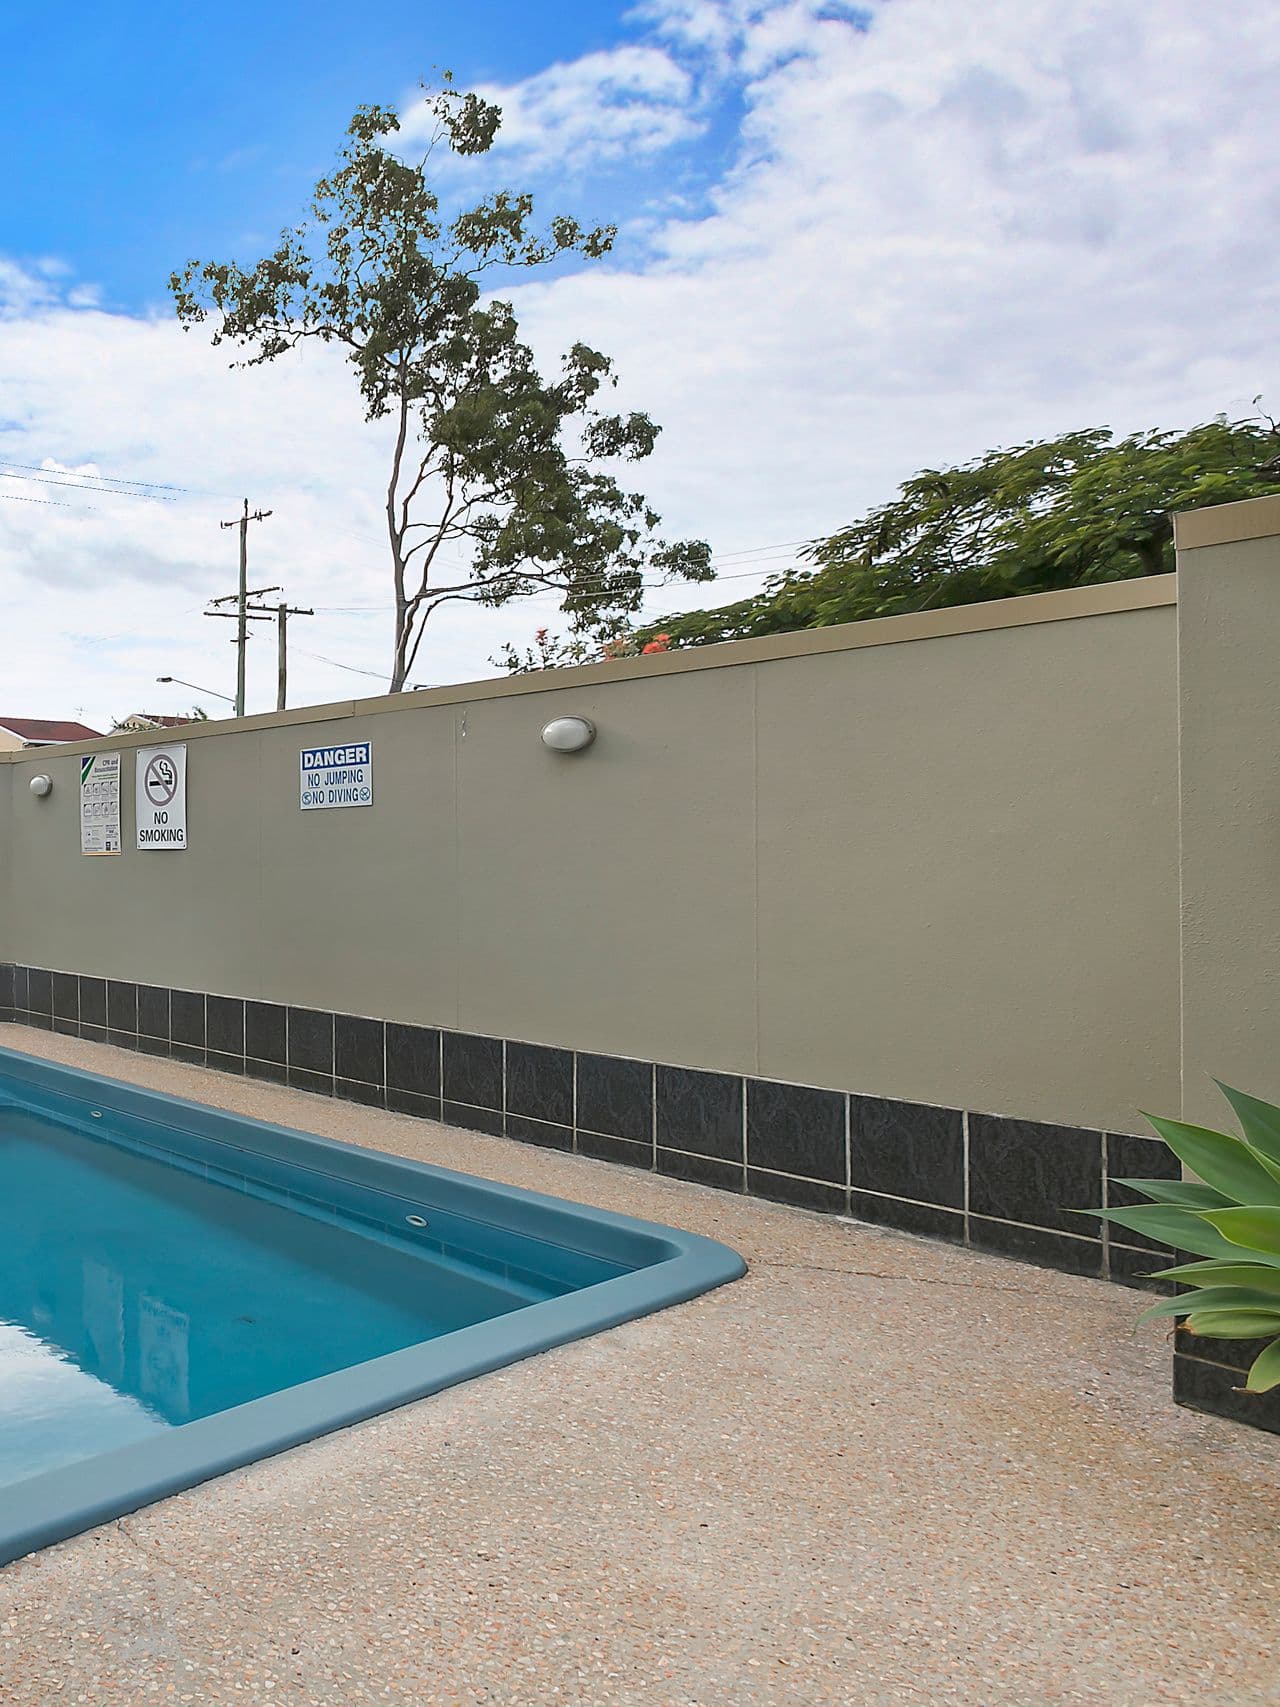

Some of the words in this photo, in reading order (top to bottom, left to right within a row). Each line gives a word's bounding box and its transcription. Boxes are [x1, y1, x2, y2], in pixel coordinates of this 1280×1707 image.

[304, 748, 367, 768] DANGER
[308, 773, 321, 787] NO
[324, 769, 363, 786] JUMPING
[313, 790, 325, 804] NO
[329, 788, 359, 803] DIVING
[154, 811, 168, 825] NO
[139, 829, 184, 842] SMOKING
